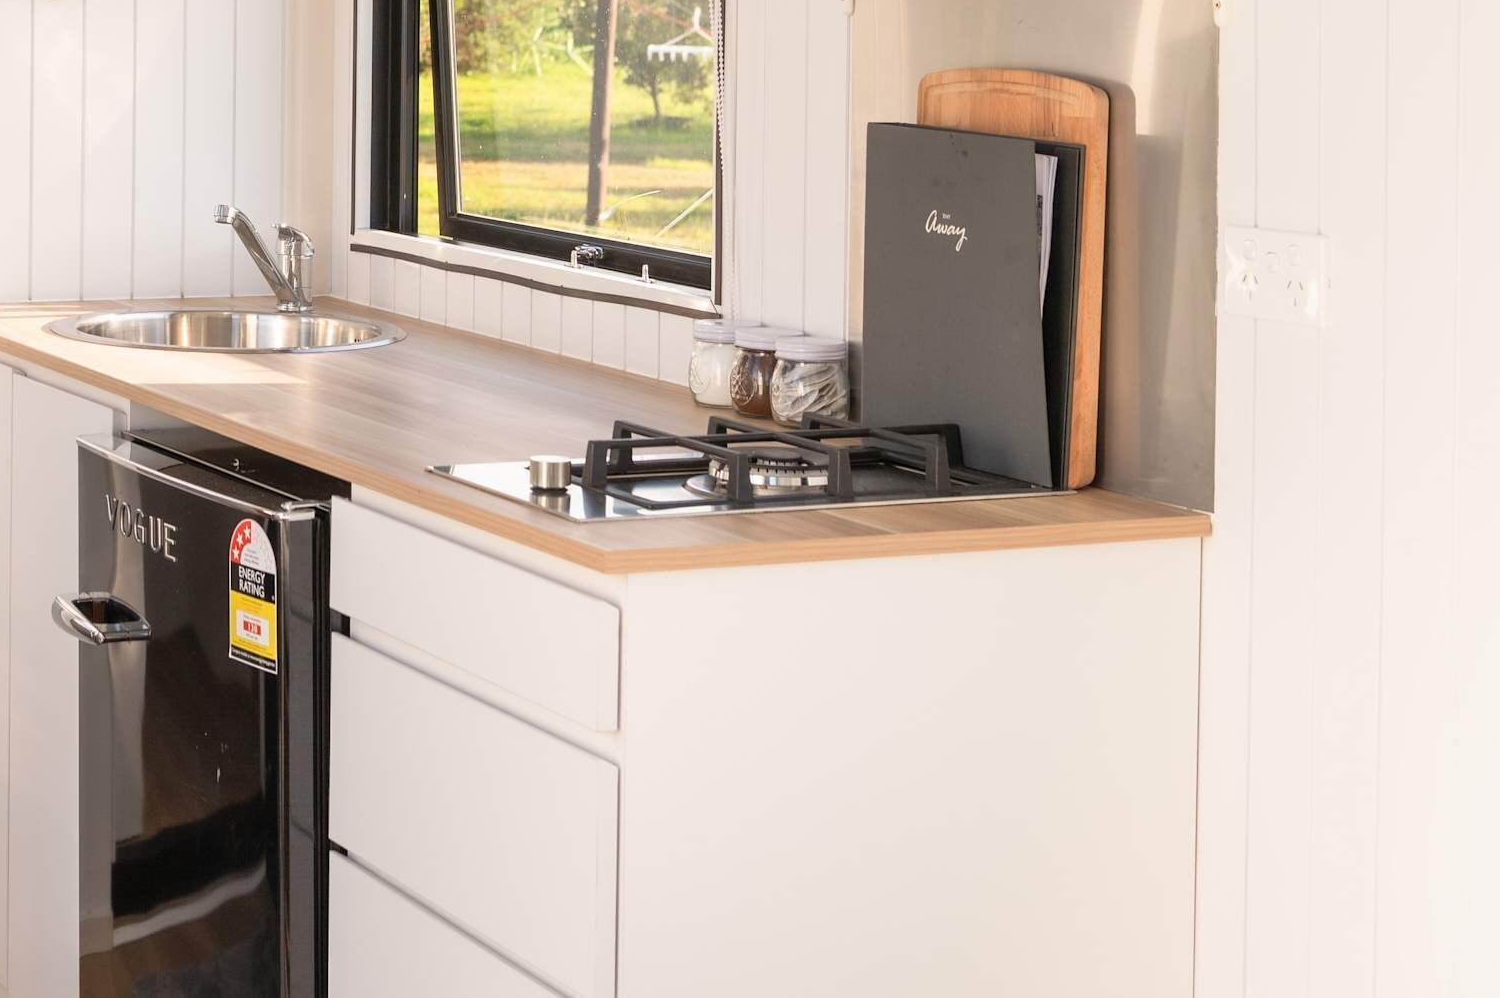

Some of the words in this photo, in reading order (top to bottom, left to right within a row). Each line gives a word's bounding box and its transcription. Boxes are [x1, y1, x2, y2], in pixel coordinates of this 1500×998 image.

[925, 209, 968, 252] Away
[105, 494, 177, 563] VOGUE
[238, 565, 266, 585] ENERGY
[239, 578, 266, 598] RATING
